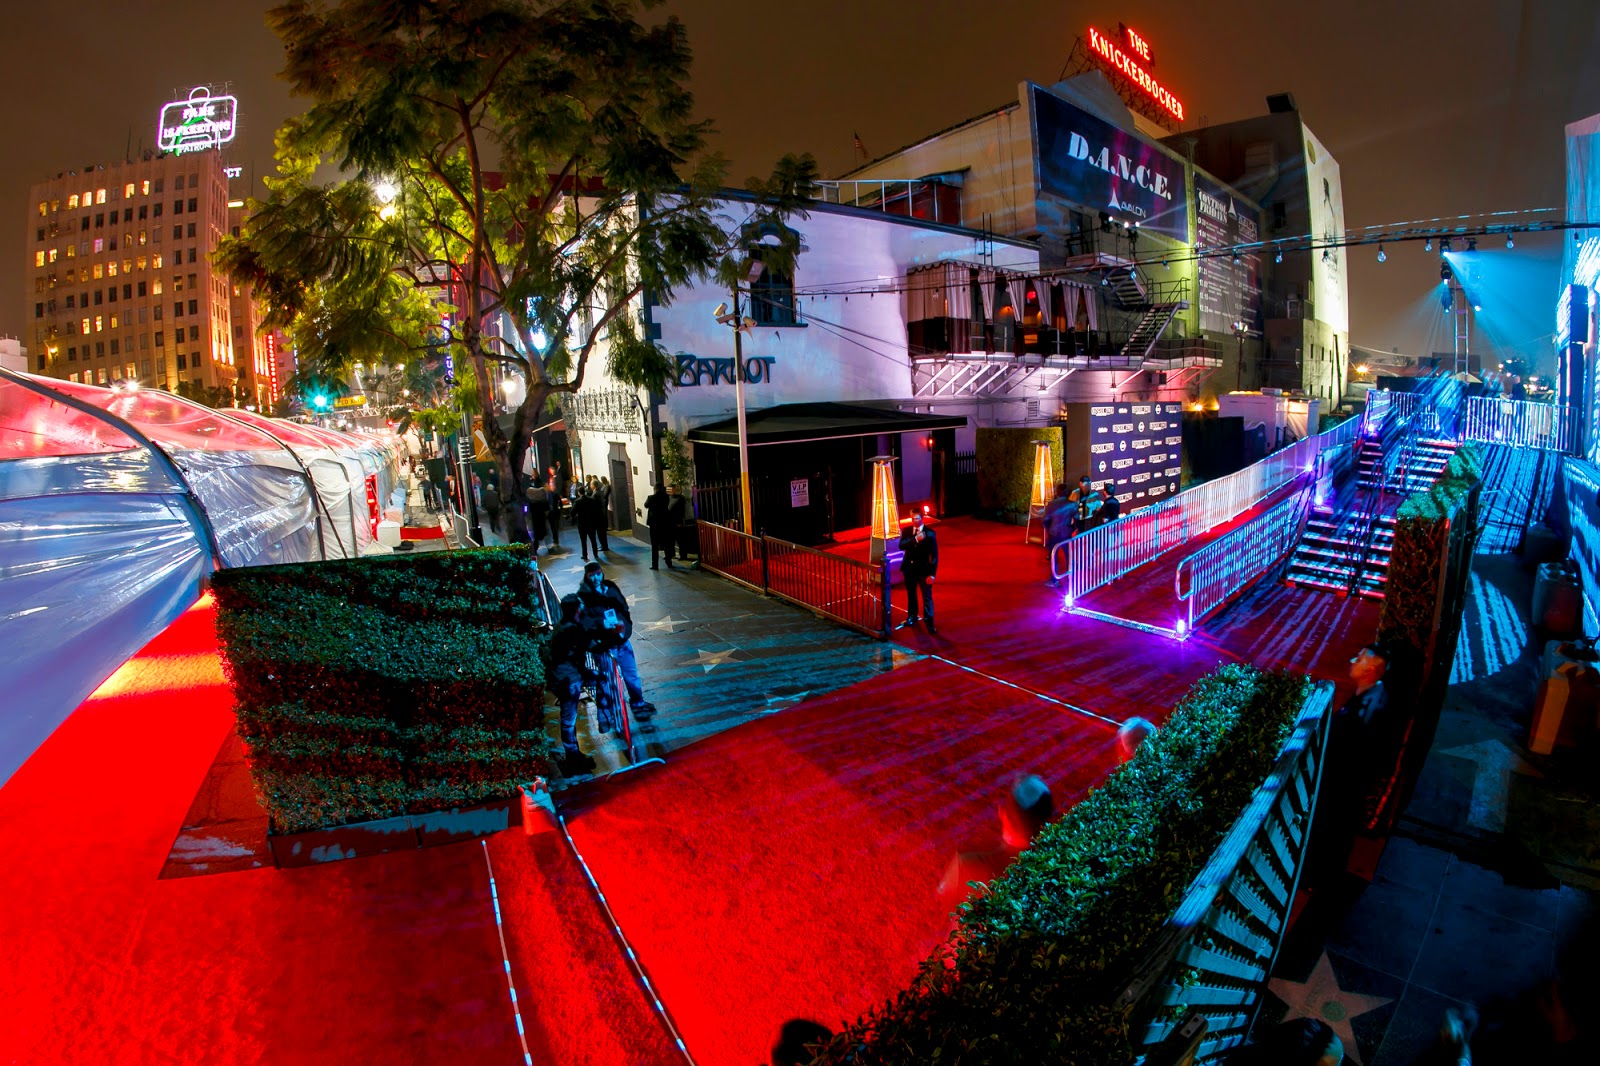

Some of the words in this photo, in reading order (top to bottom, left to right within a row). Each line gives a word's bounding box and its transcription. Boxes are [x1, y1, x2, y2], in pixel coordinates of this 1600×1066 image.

[1127, 28, 1151, 61] THE
[1089, 27, 1184, 121] KNICKERBOCKER
[1067, 131, 1172, 201] D.A.N.C.E.
[1121, 201, 1147, 218] AVALON
